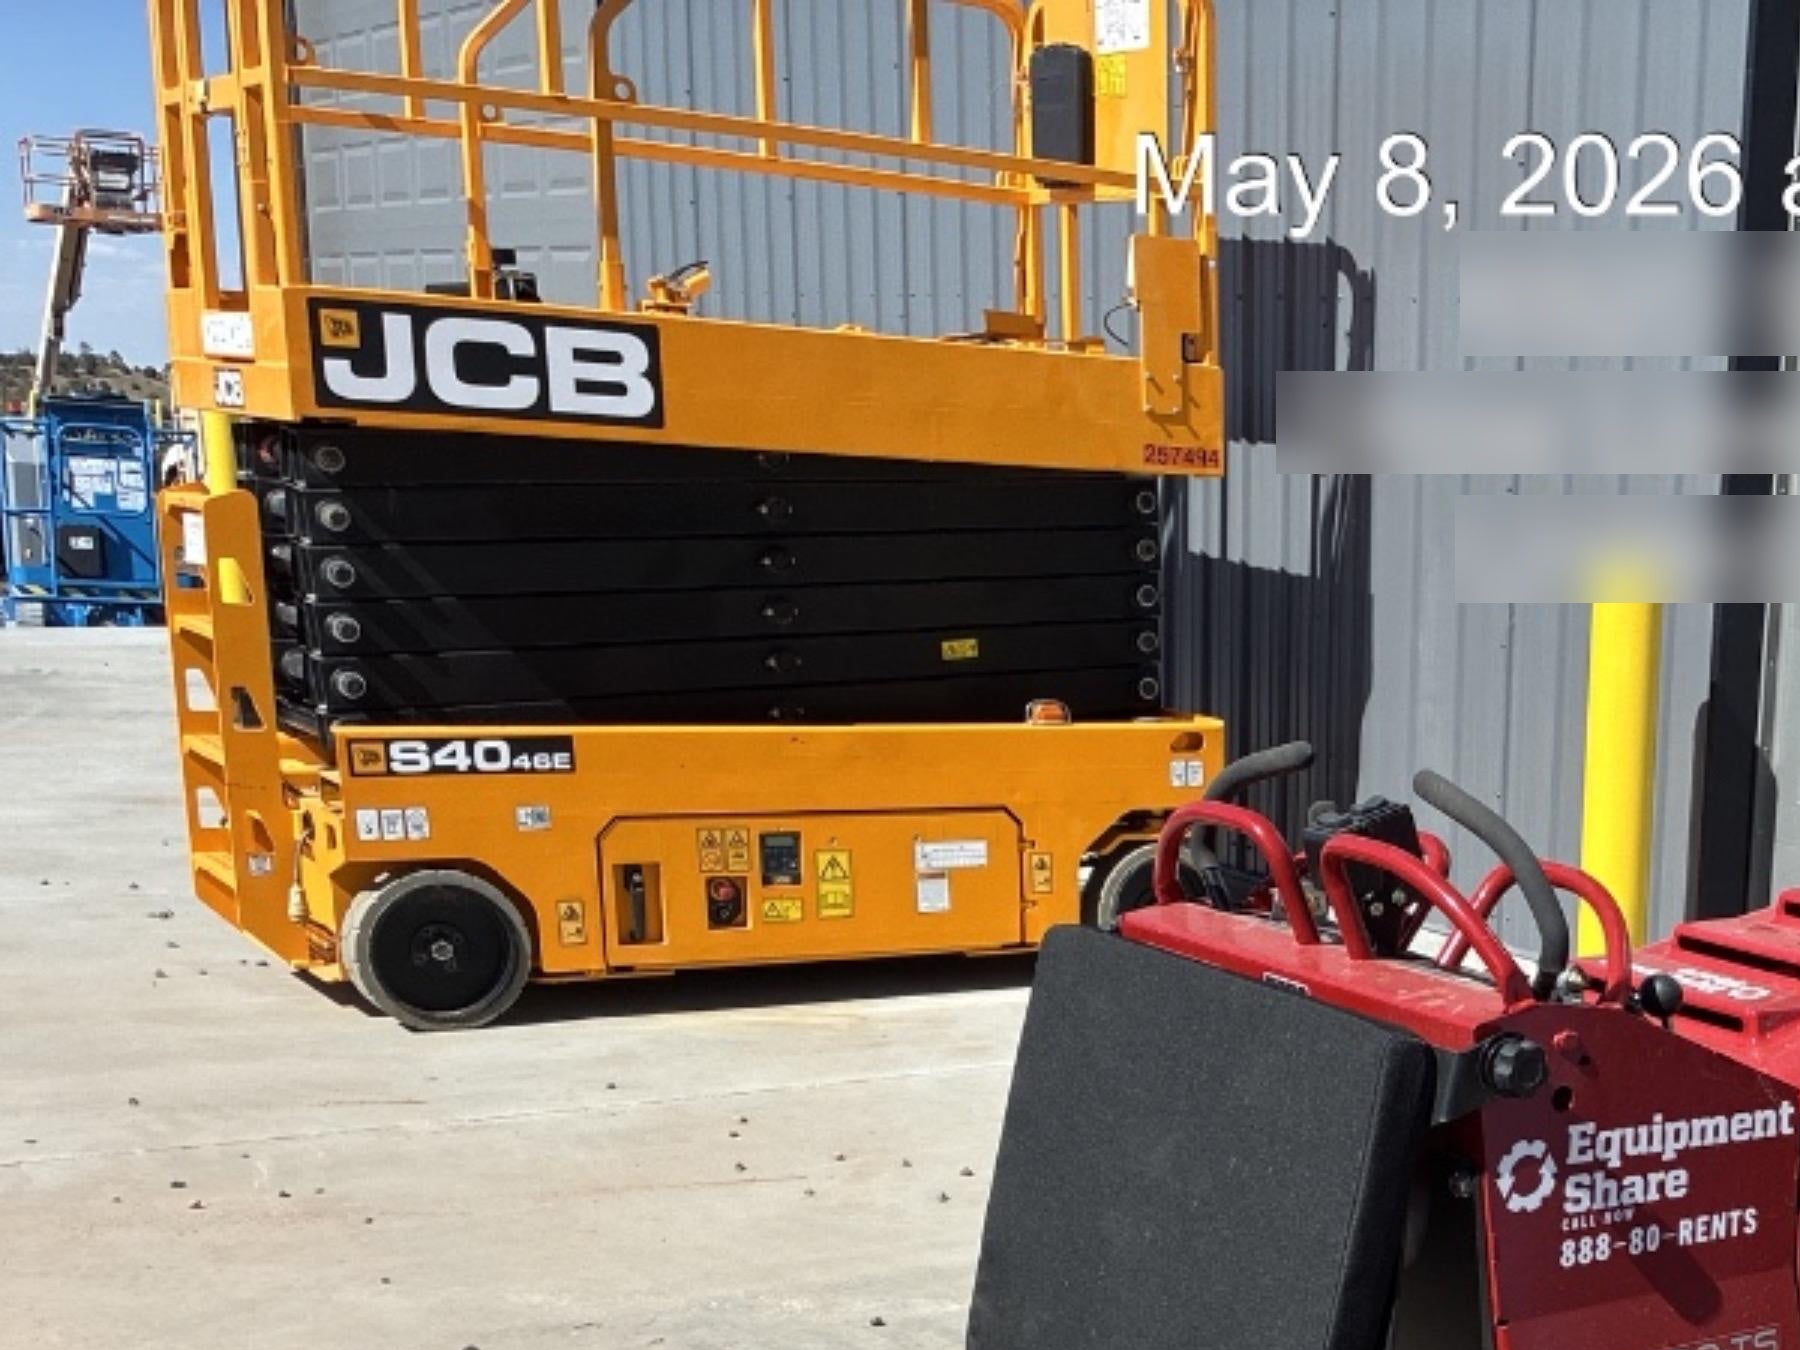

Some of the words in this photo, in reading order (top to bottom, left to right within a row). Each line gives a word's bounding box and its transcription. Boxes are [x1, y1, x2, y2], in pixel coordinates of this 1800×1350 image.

[322, 312, 656, 418] JCB
[1566, 1100, 1796, 1168] Equipment
[1562, 1167, 1690, 1214] Share
[1559, 1206, 1759, 1268] 888-80-RENTS
